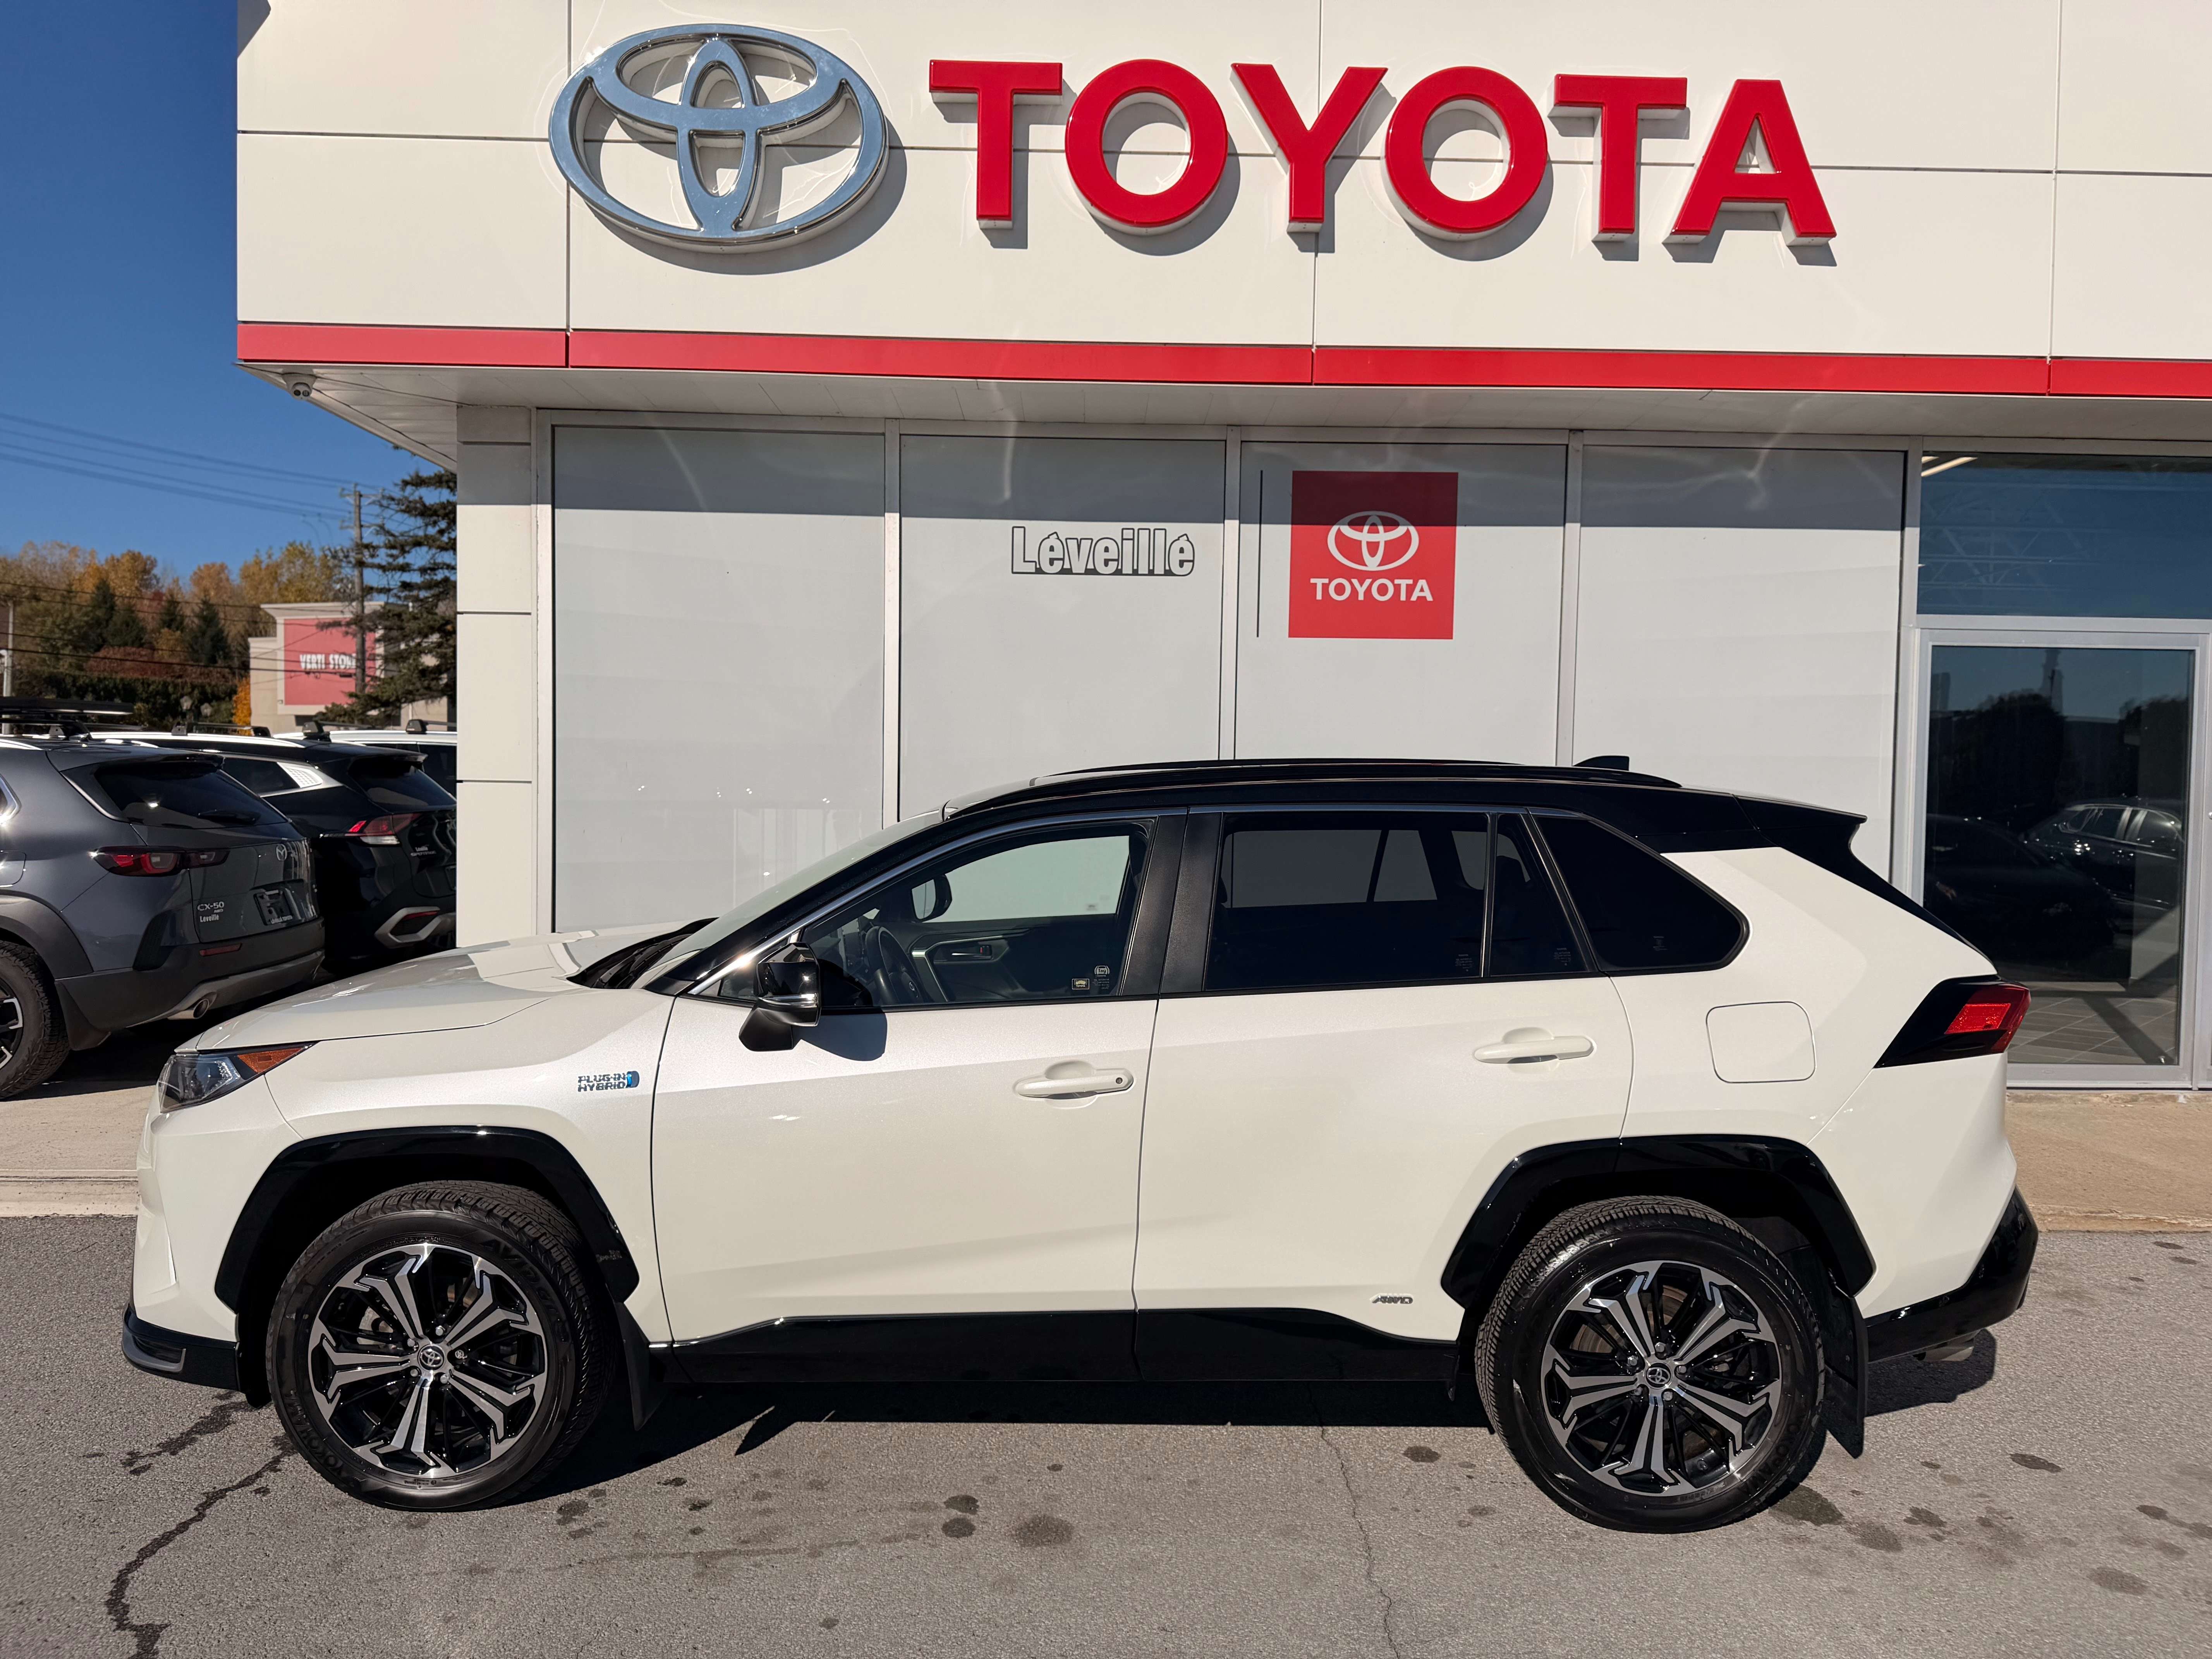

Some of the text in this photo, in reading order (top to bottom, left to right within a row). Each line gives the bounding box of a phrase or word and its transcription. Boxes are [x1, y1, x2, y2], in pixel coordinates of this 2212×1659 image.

[929, 58, 1837, 242] TOYOTA
[1012, 526, 1195, 576] Léveillé
[1310, 577, 1434, 601] TOYOTA
[300, 654, 325, 669] VERTI
[197, 901, 225, 911] CX-50
[577, 1073, 626, 1084] PLUG-IN
[577, 1081, 626, 1092] HYBRID
[1372, 1296, 1413, 1304] AWD
